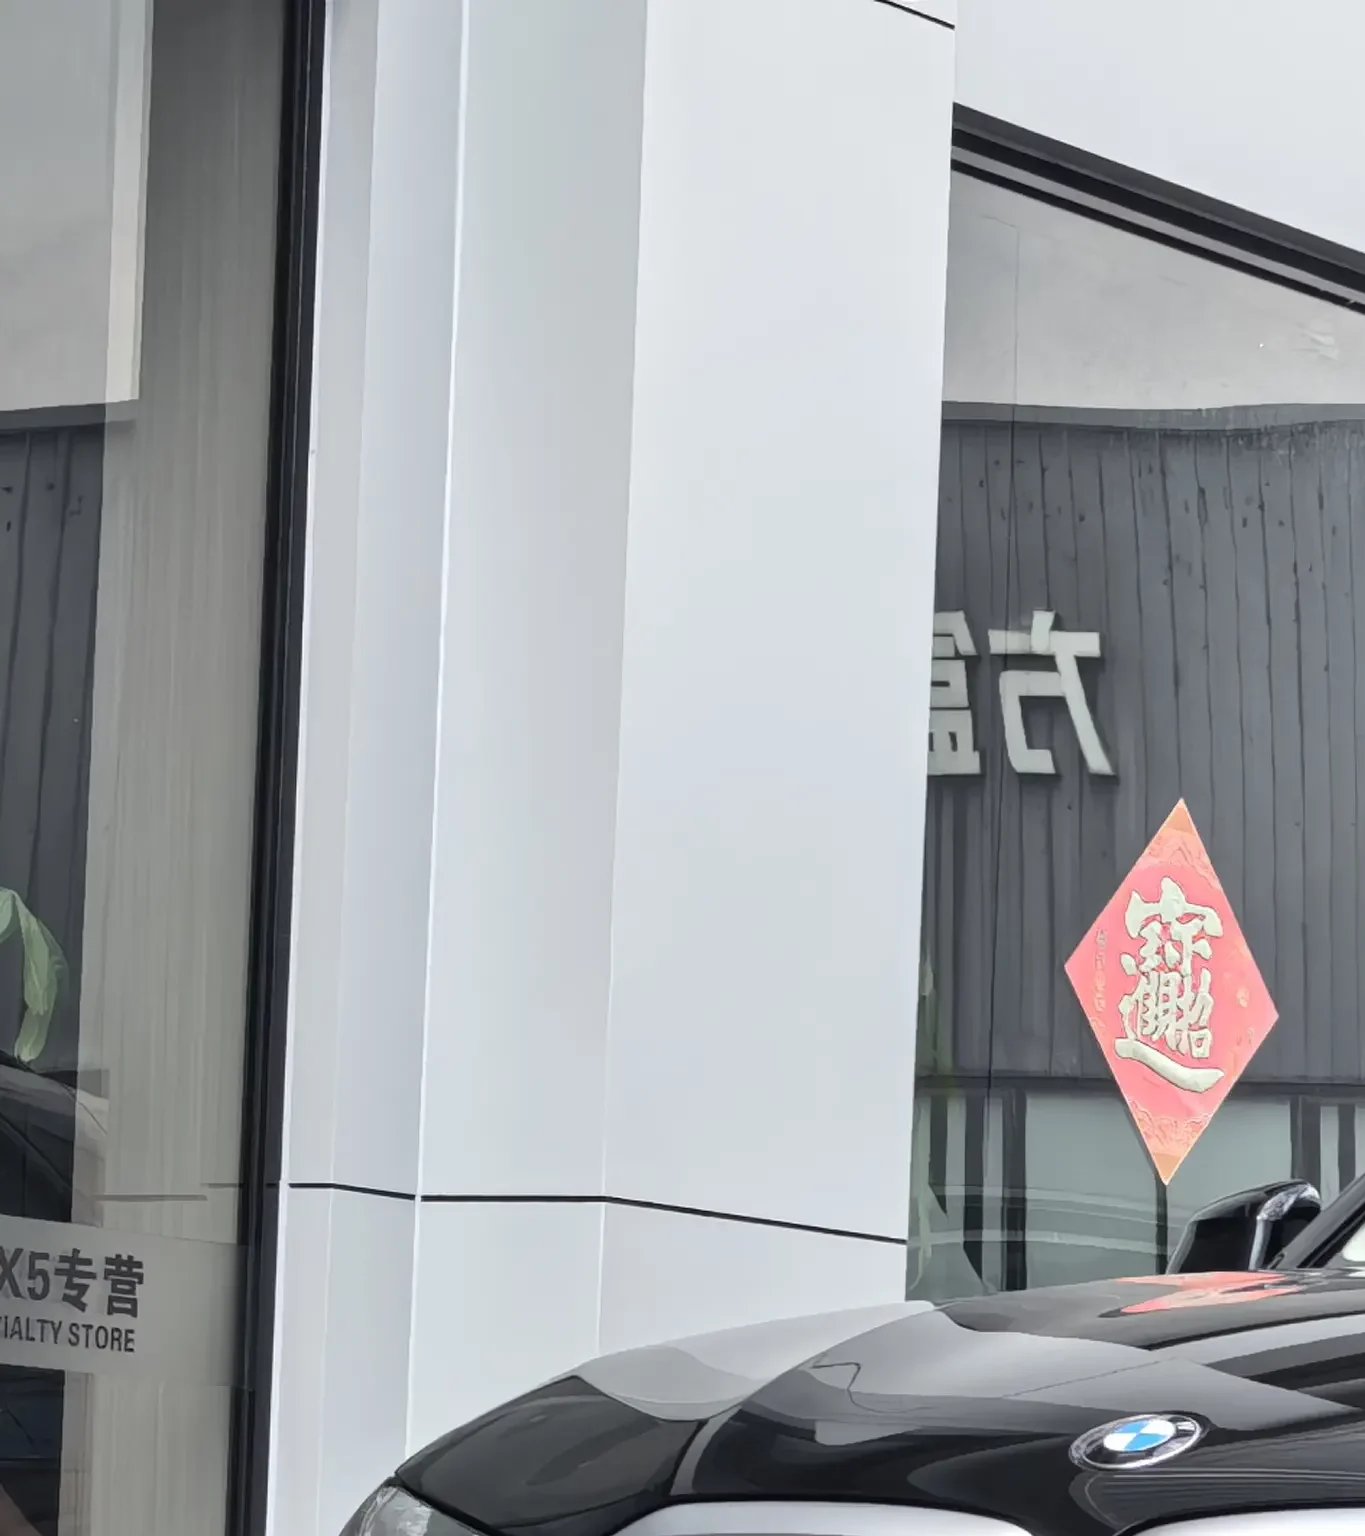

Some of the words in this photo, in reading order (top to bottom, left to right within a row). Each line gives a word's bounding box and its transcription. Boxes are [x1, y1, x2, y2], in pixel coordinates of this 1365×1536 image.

[0, 1246, 144, 1318] X5专营
[0, 1315, 62, 1344] IALTY
[67, 1322, 136, 1352] STORE
